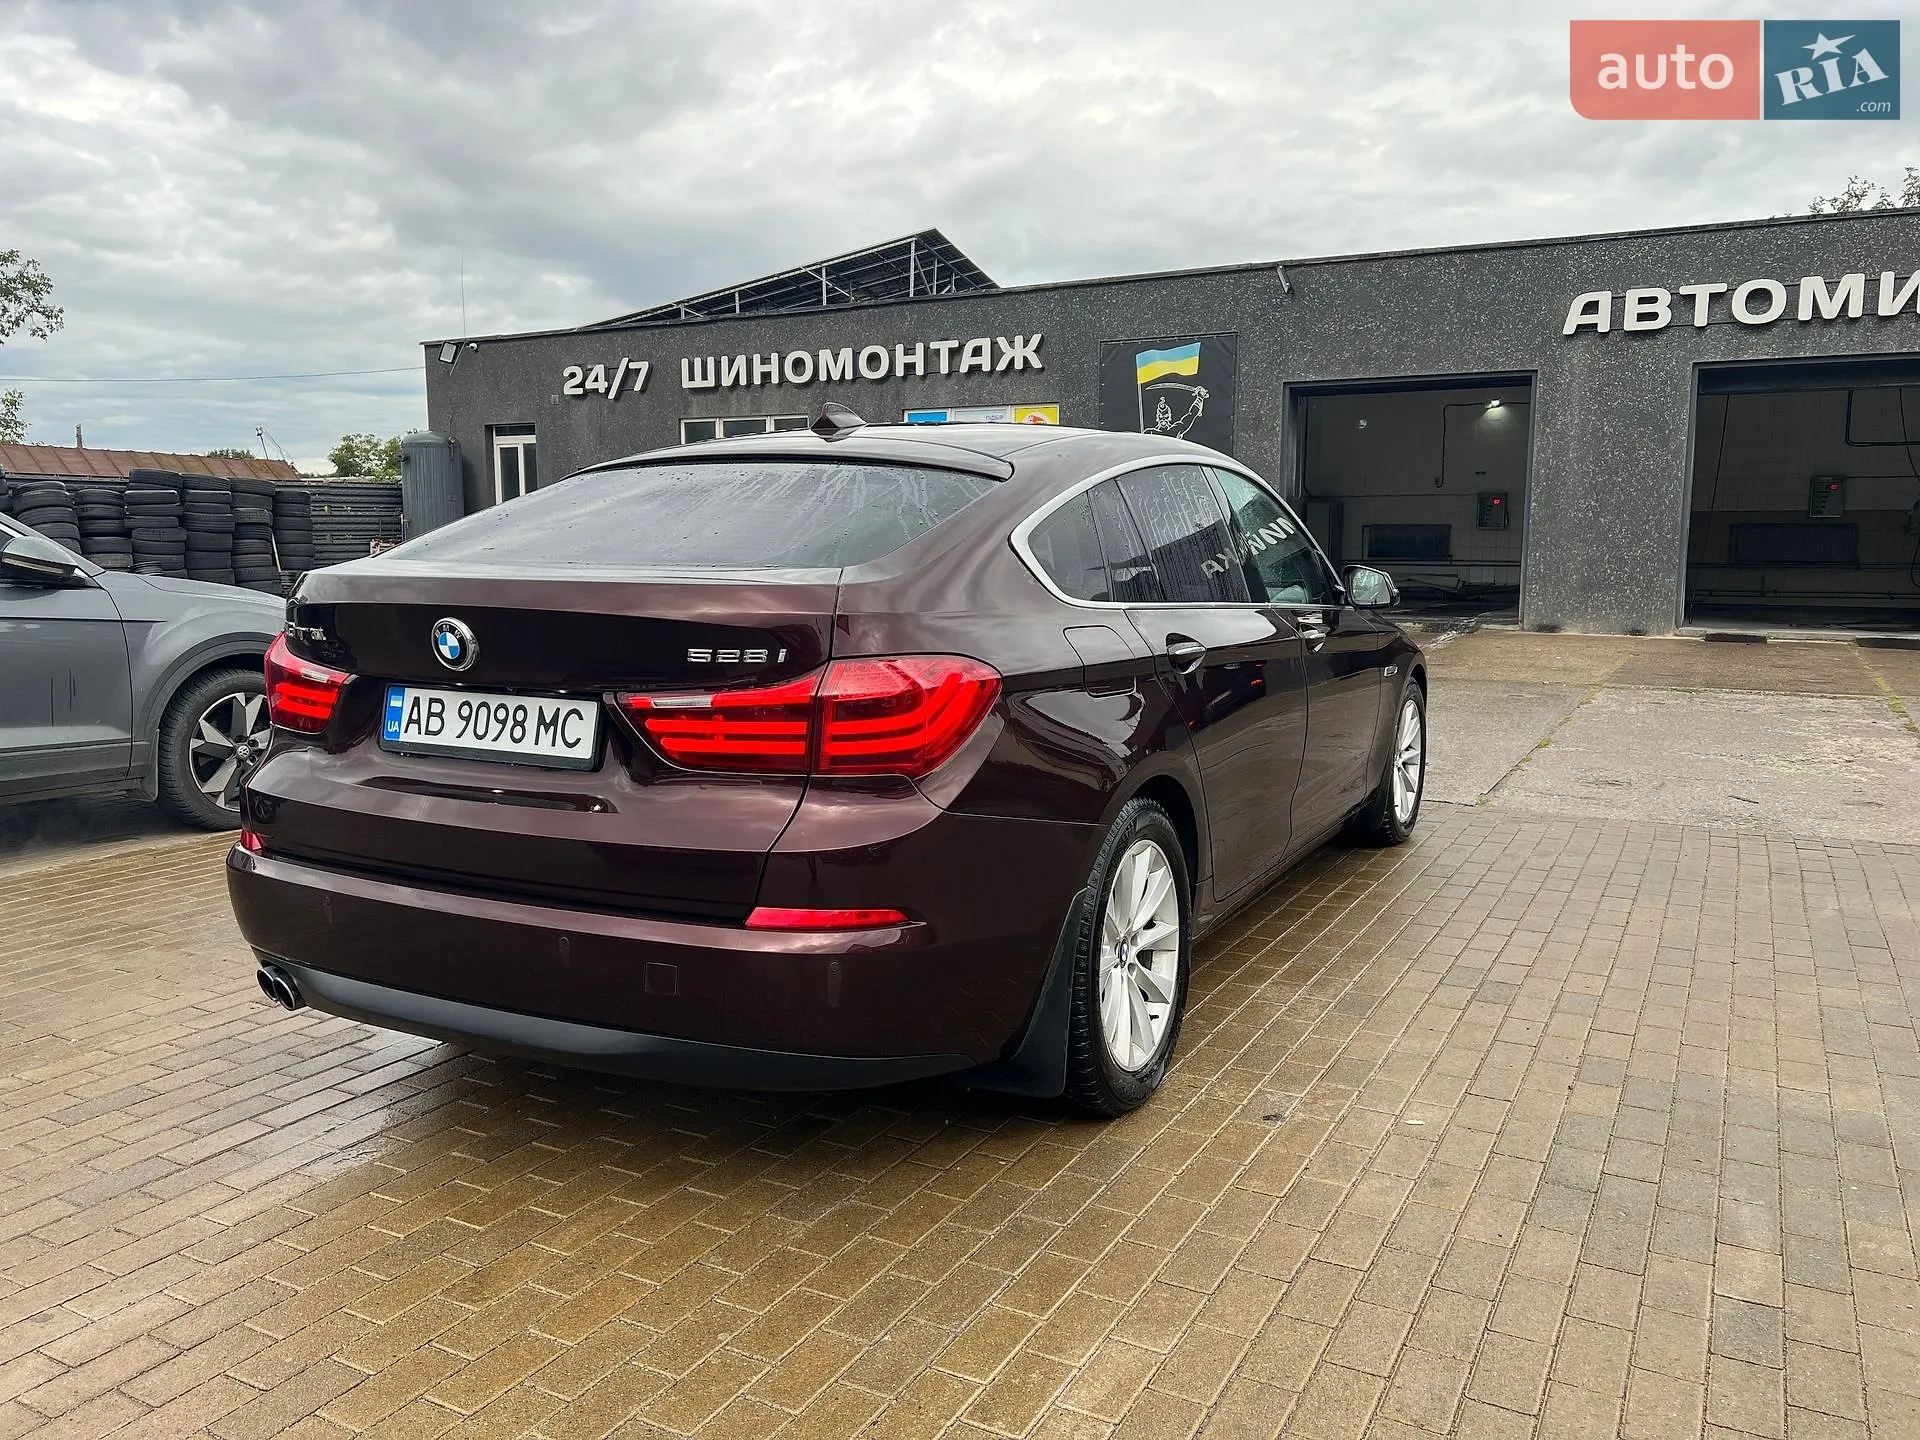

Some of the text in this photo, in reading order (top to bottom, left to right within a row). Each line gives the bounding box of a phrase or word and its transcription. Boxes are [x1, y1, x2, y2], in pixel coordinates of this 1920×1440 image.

[562, 333, 1044, 400] 24/7 ШИНОМОНТАЖ
[687, 648, 787, 663] 528i
[387, 720, 399, 733] UA
[404, 696, 584, 749] AB 9098 MC
